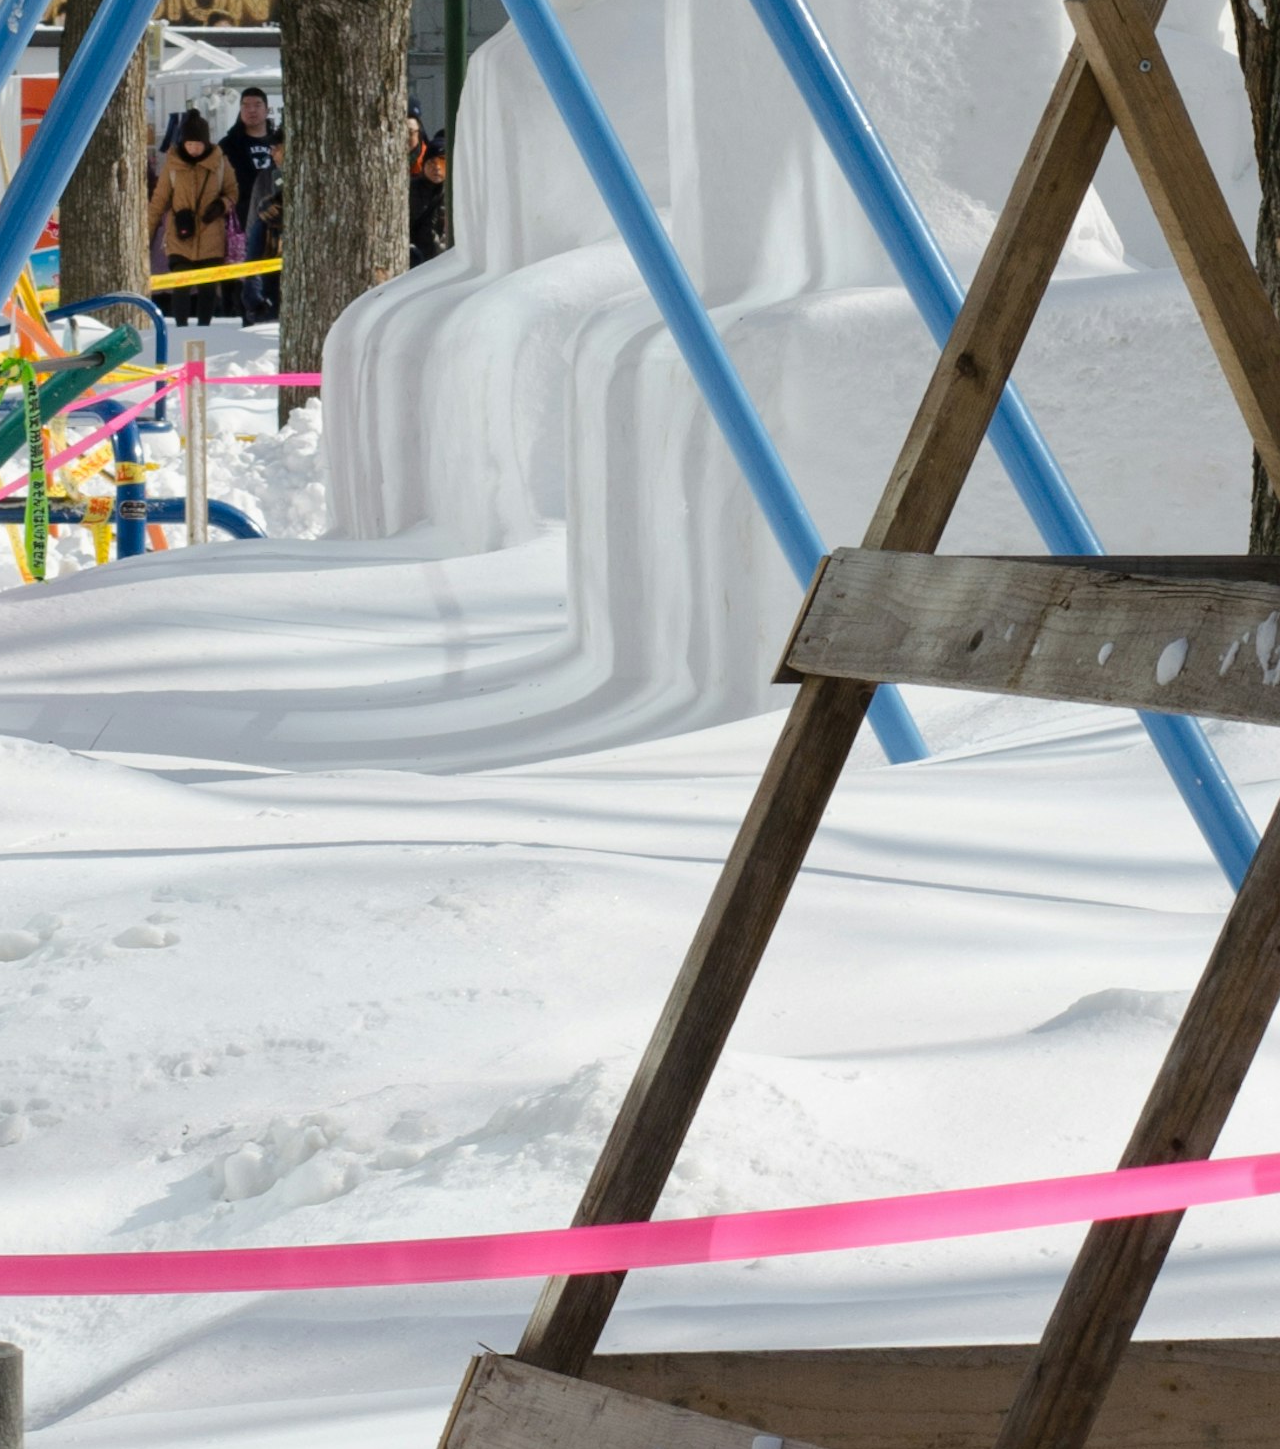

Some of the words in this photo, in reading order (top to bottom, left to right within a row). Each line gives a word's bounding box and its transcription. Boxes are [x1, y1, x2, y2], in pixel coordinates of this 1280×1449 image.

[32, 480, 47, 569] あそんではいけません
